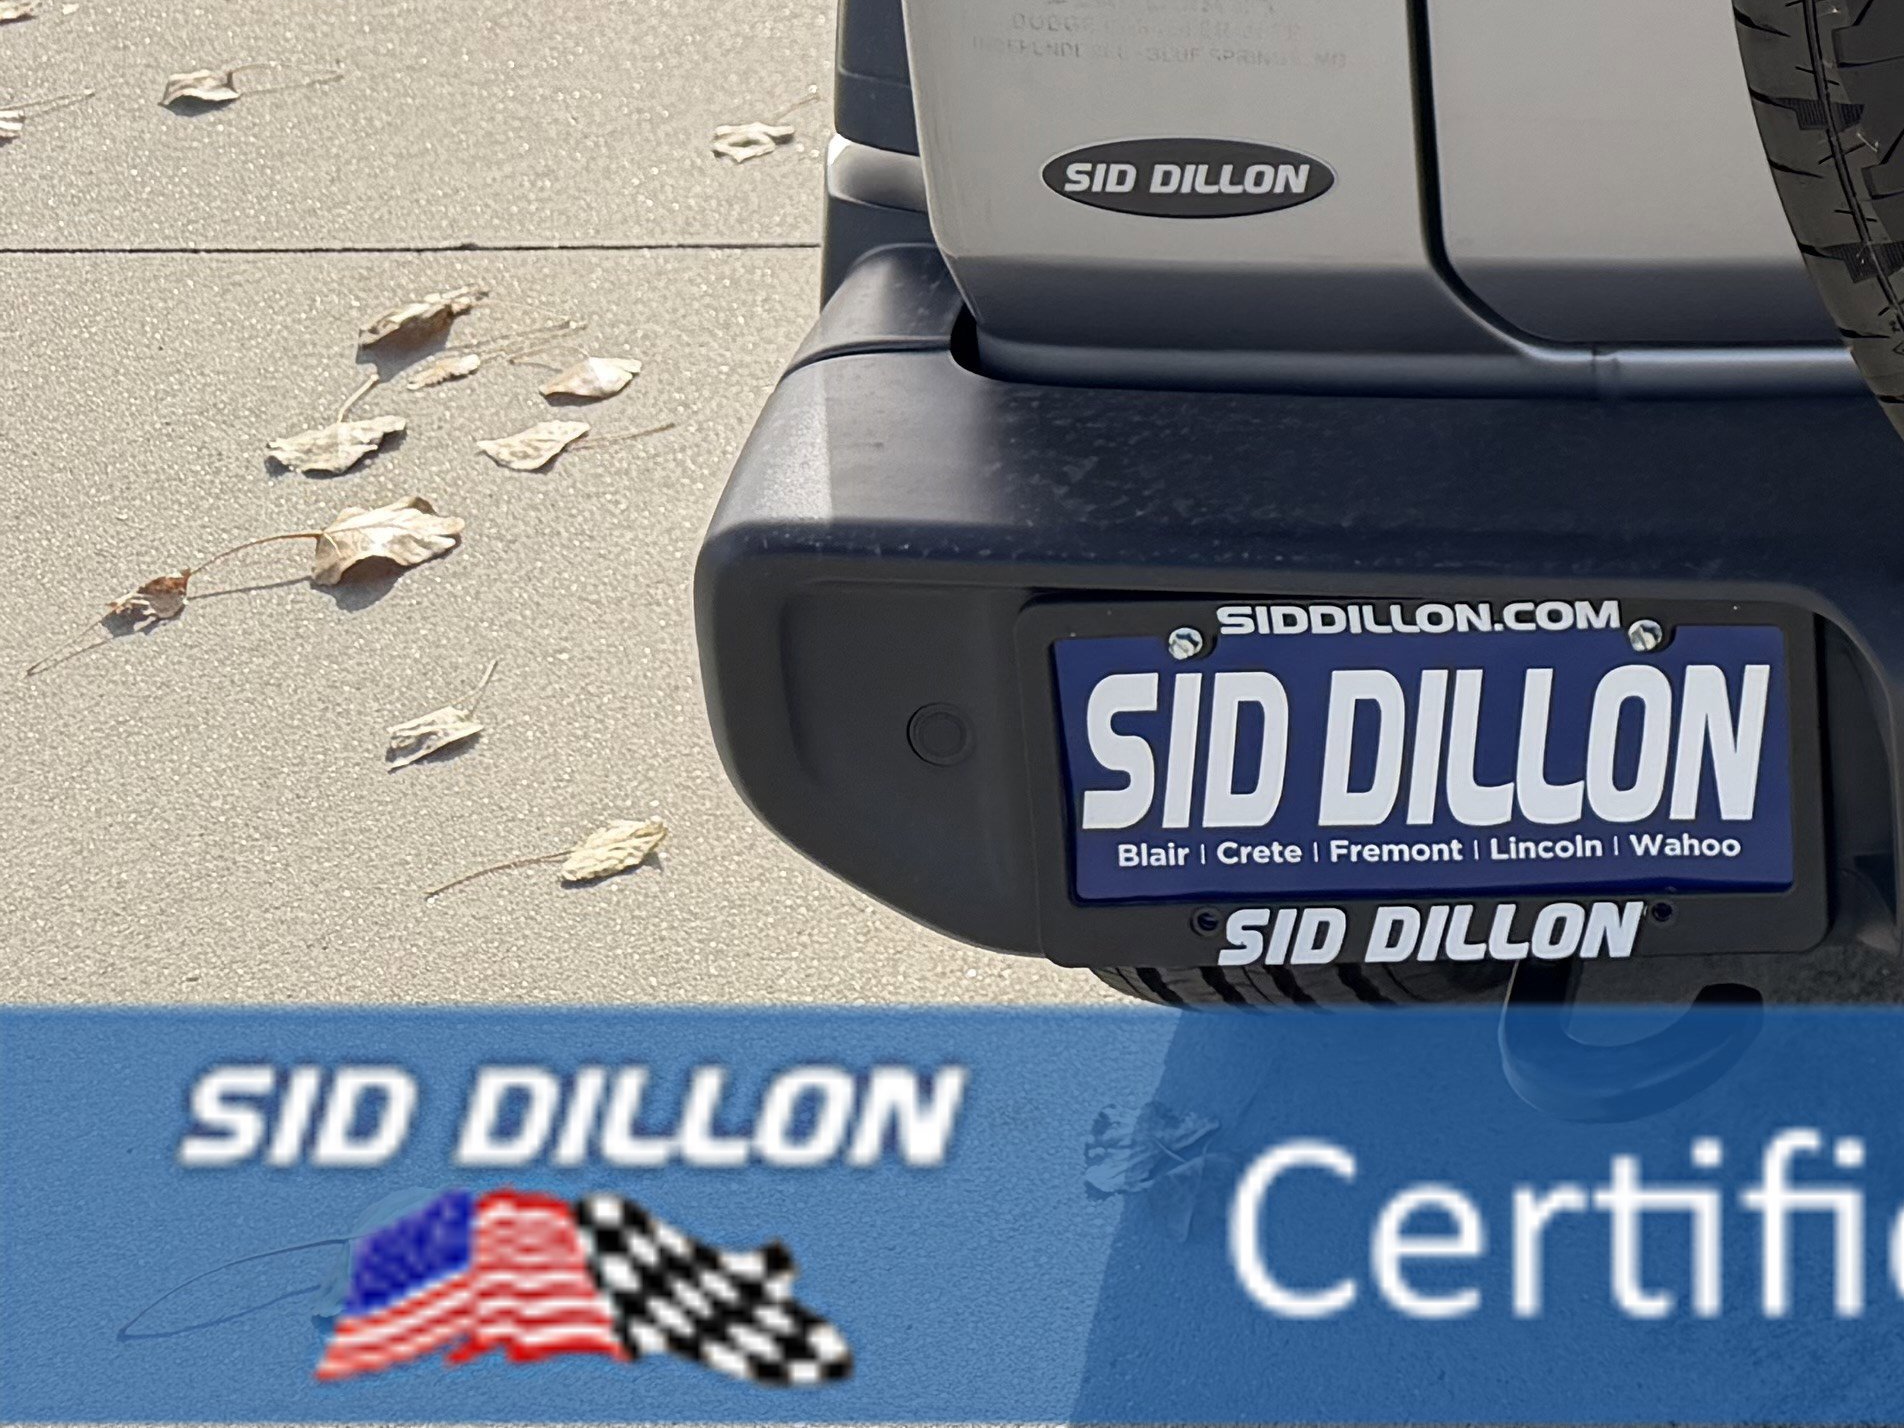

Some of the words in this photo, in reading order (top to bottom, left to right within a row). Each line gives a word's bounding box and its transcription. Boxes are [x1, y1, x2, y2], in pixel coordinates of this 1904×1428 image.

[1063, 161, 1136, 194] SID
[1149, 163, 1310, 194] DILLON
[1216, 600, 1621, 635] SIDDILLON.COM
[1082, 671, 1289, 830] SID
[1318, 663, 1771, 827] DILLON
[1118, 842, 1190, 867] Blair
[1216, 841, 1303, 865] Crete
[1330, 839, 1463, 863] Fremont
[1490, 834, 1603, 860] Lincoln
[1629, 832, 1741, 857] Wahoo
[1217, 908, 1350, 966] SID
[1364, 901, 1646, 963] DILLON
